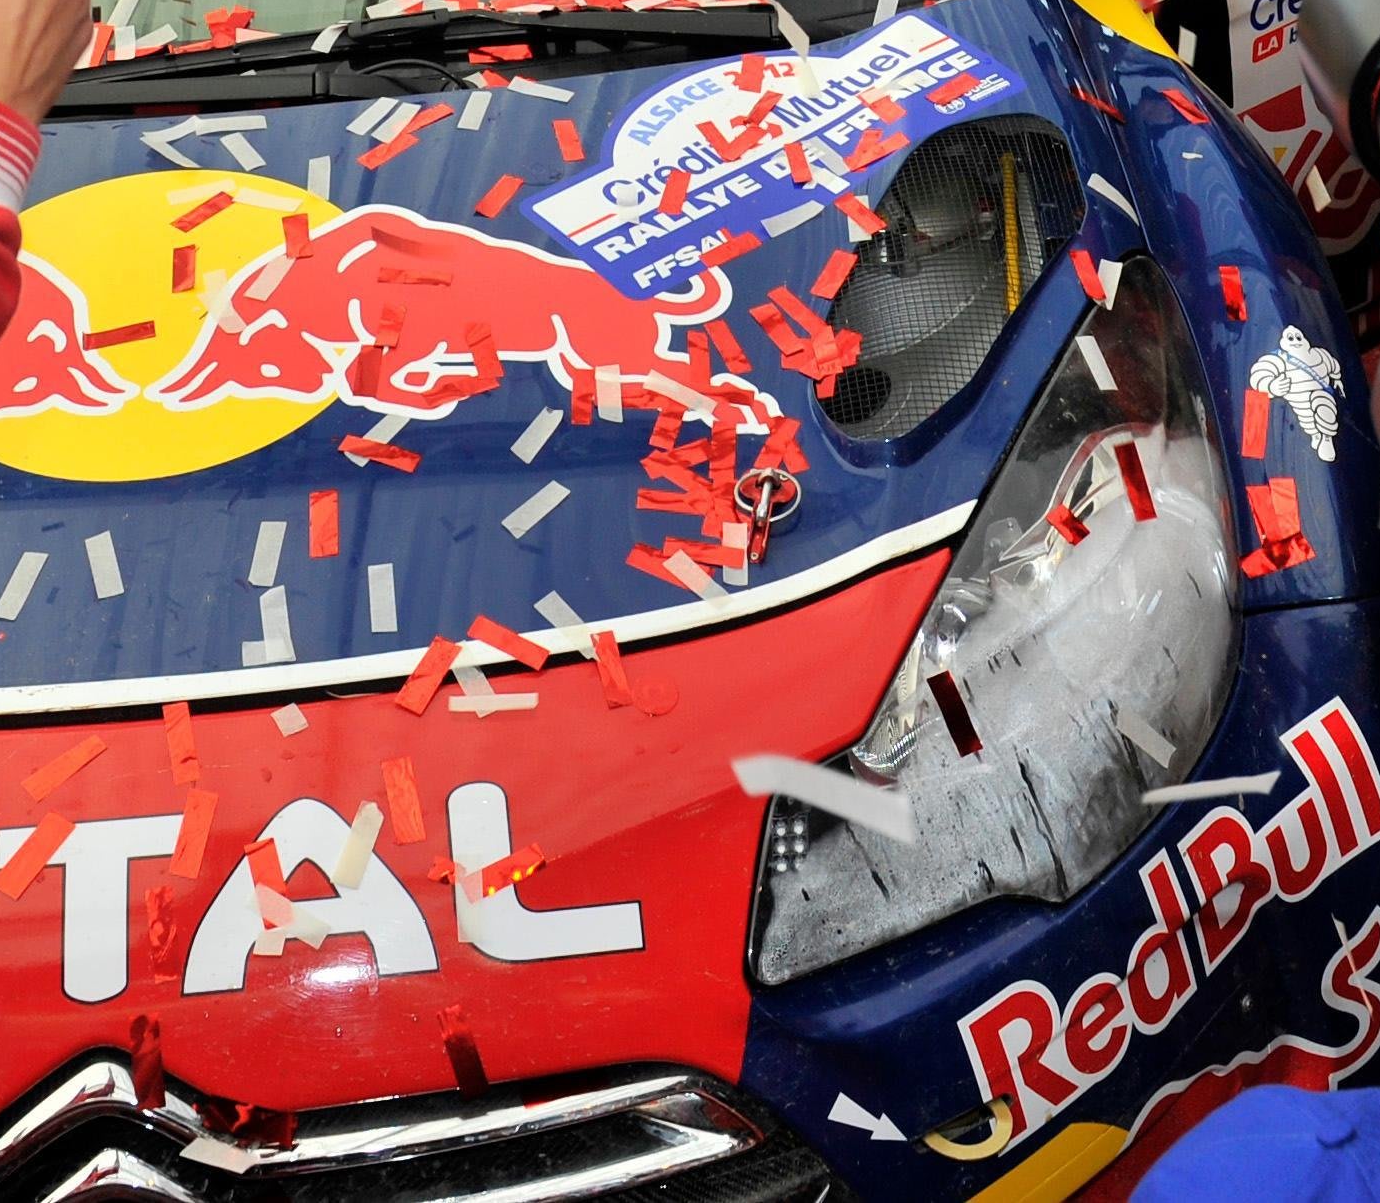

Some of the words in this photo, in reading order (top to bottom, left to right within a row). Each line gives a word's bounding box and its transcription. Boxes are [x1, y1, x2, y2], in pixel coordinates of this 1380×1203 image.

[1257, 38, 1278, 57] LA
[602, 138, 725, 208] Crédi
[771, 43, 912, 129] Mutuel
[628, 76, 724, 147] ALSACE
[722, 61, 795, 87] 212
[593, 172, 763, 264] RALLYE
[957, 848, 1198, 1157] Red
